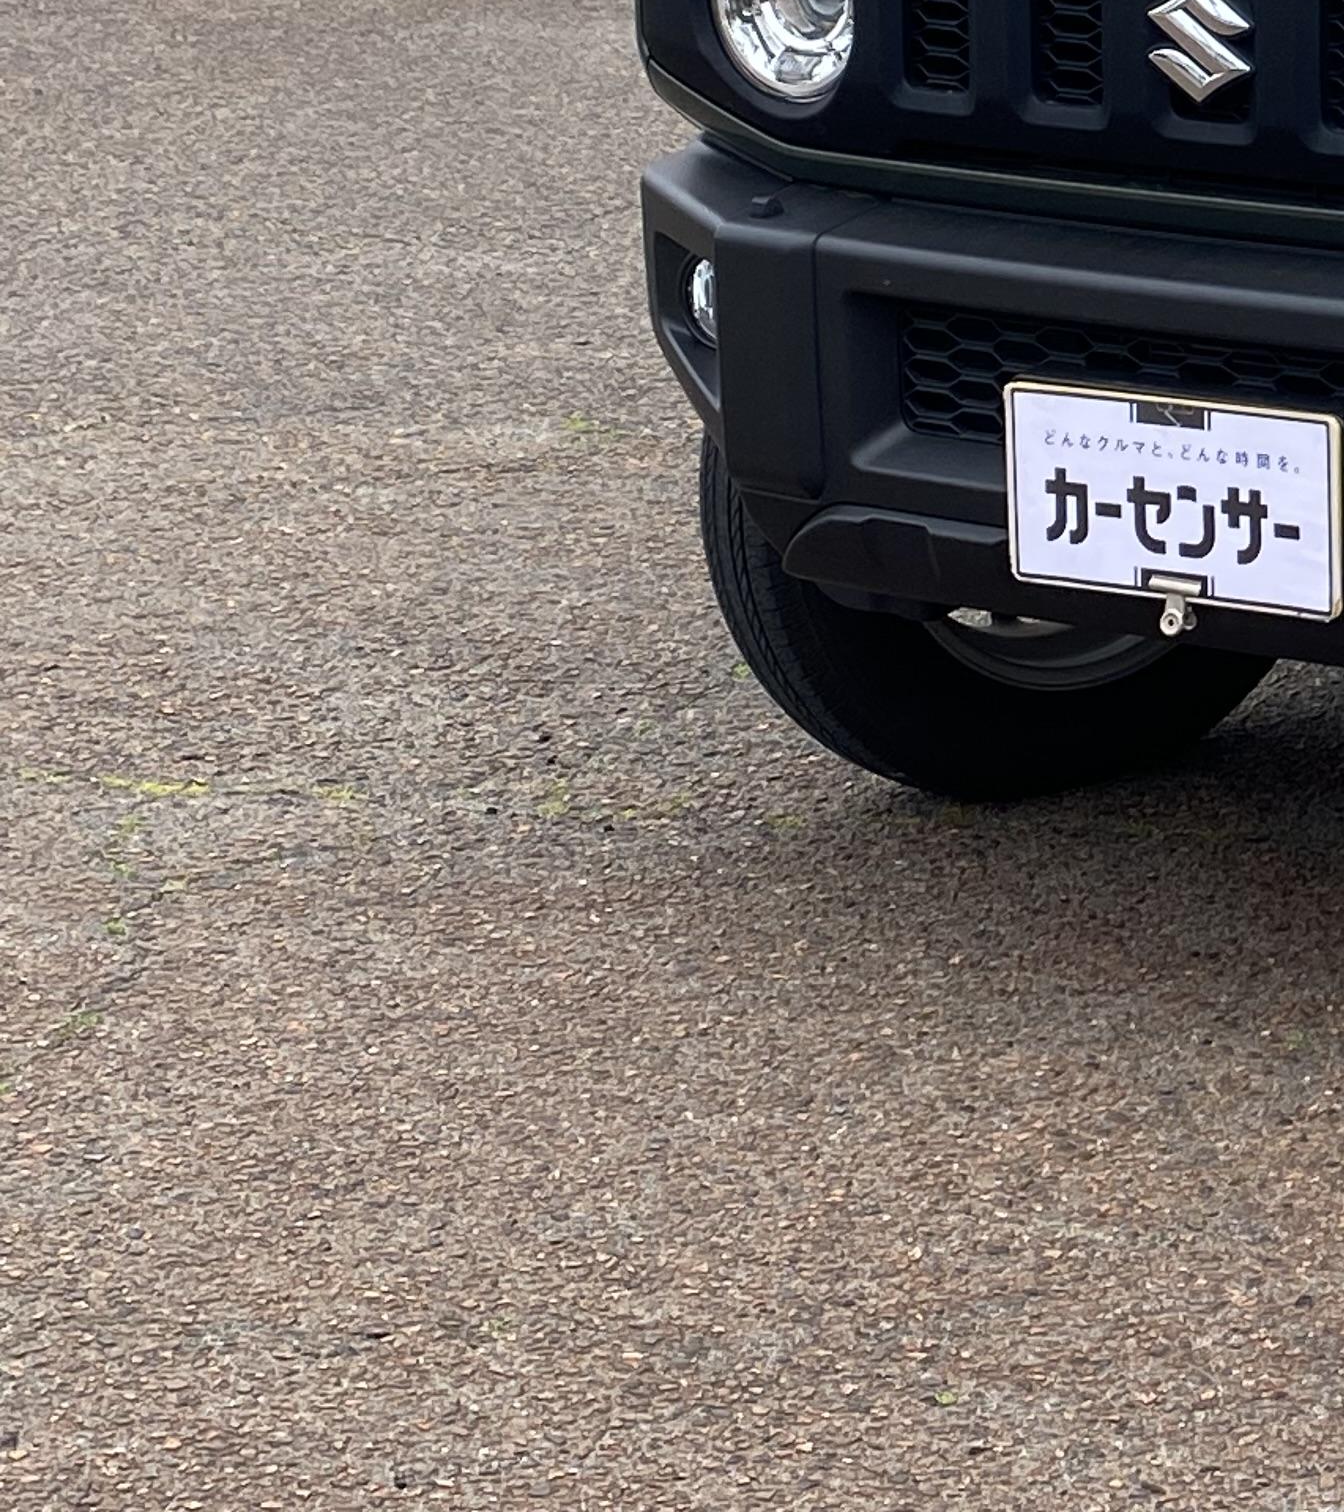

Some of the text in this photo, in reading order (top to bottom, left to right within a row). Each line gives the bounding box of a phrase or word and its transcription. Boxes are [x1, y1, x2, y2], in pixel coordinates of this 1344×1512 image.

[1044, 465, 1302, 566] カーセンサー
